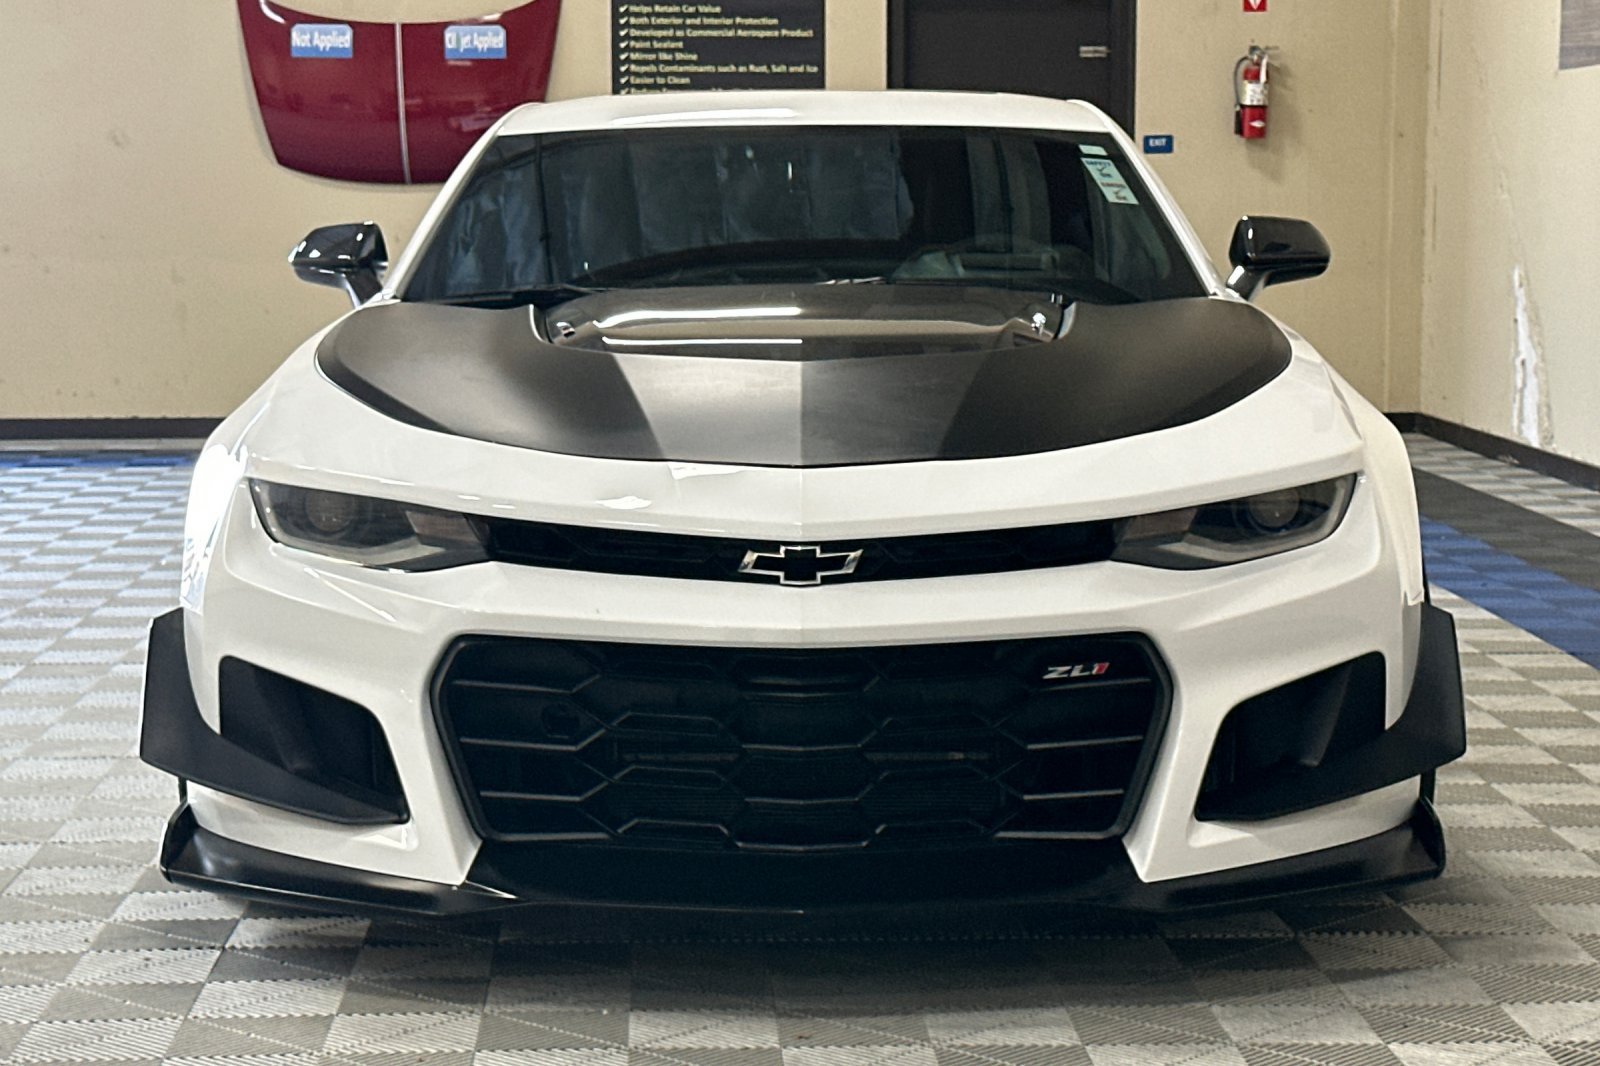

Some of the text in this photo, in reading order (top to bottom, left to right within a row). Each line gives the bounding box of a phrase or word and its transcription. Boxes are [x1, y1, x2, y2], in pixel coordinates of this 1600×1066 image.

[628, 5, 721, 14] Helps Retain Car Value
[629, 17, 779, 25] Both Exterior and Interior Protection
[629, 28, 674, 38] Developed
[686, 28, 735, 37] Commercial
[736, 29, 779, 38] Aerospace
[780, 28, 814, 37] Product
[291, 31, 351, 52] Not Applied
[473, 32, 504, 52] Applied
[629, 40, 651, 48] Paint
[630, 52, 657, 60] Mirror
[674, 52, 698, 60] Shine
[658, 64, 716, 73] Contaminants
[717, 64, 737, 73] such
[738, 65, 748, 73] as
[771, 64, 787, 73] Salt
[788, 64, 804, 73] and
[630, 76, 691, 84] Easier to Clean
[1149, 138, 1167, 147] EXIT
[1042, 662, 1110, 679] ZL1
